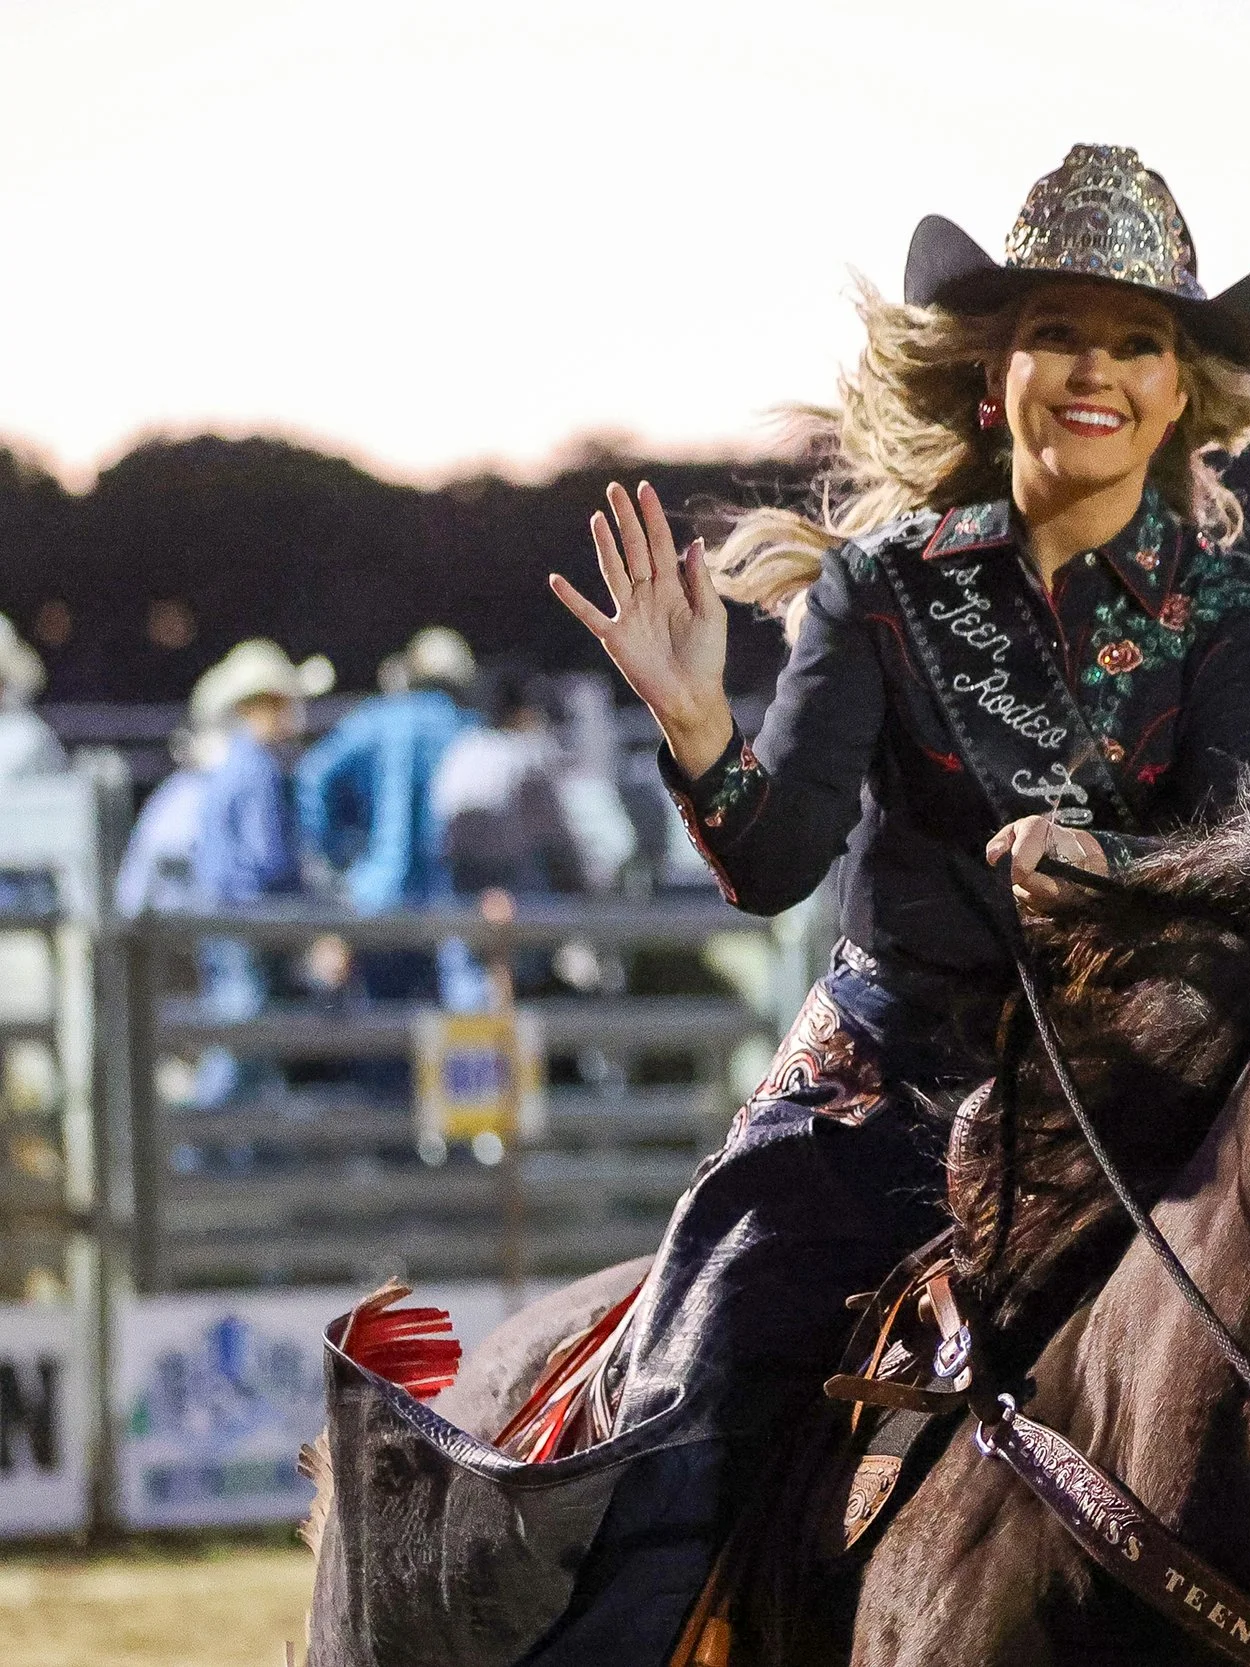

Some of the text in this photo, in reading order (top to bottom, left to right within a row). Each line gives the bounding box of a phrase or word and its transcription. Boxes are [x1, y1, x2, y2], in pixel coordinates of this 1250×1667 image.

[953, 668, 1067, 748] Rodeo
[1020, 1435, 1070, 1490] 2026
[1077, 1493, 1143, 1562] MISS
